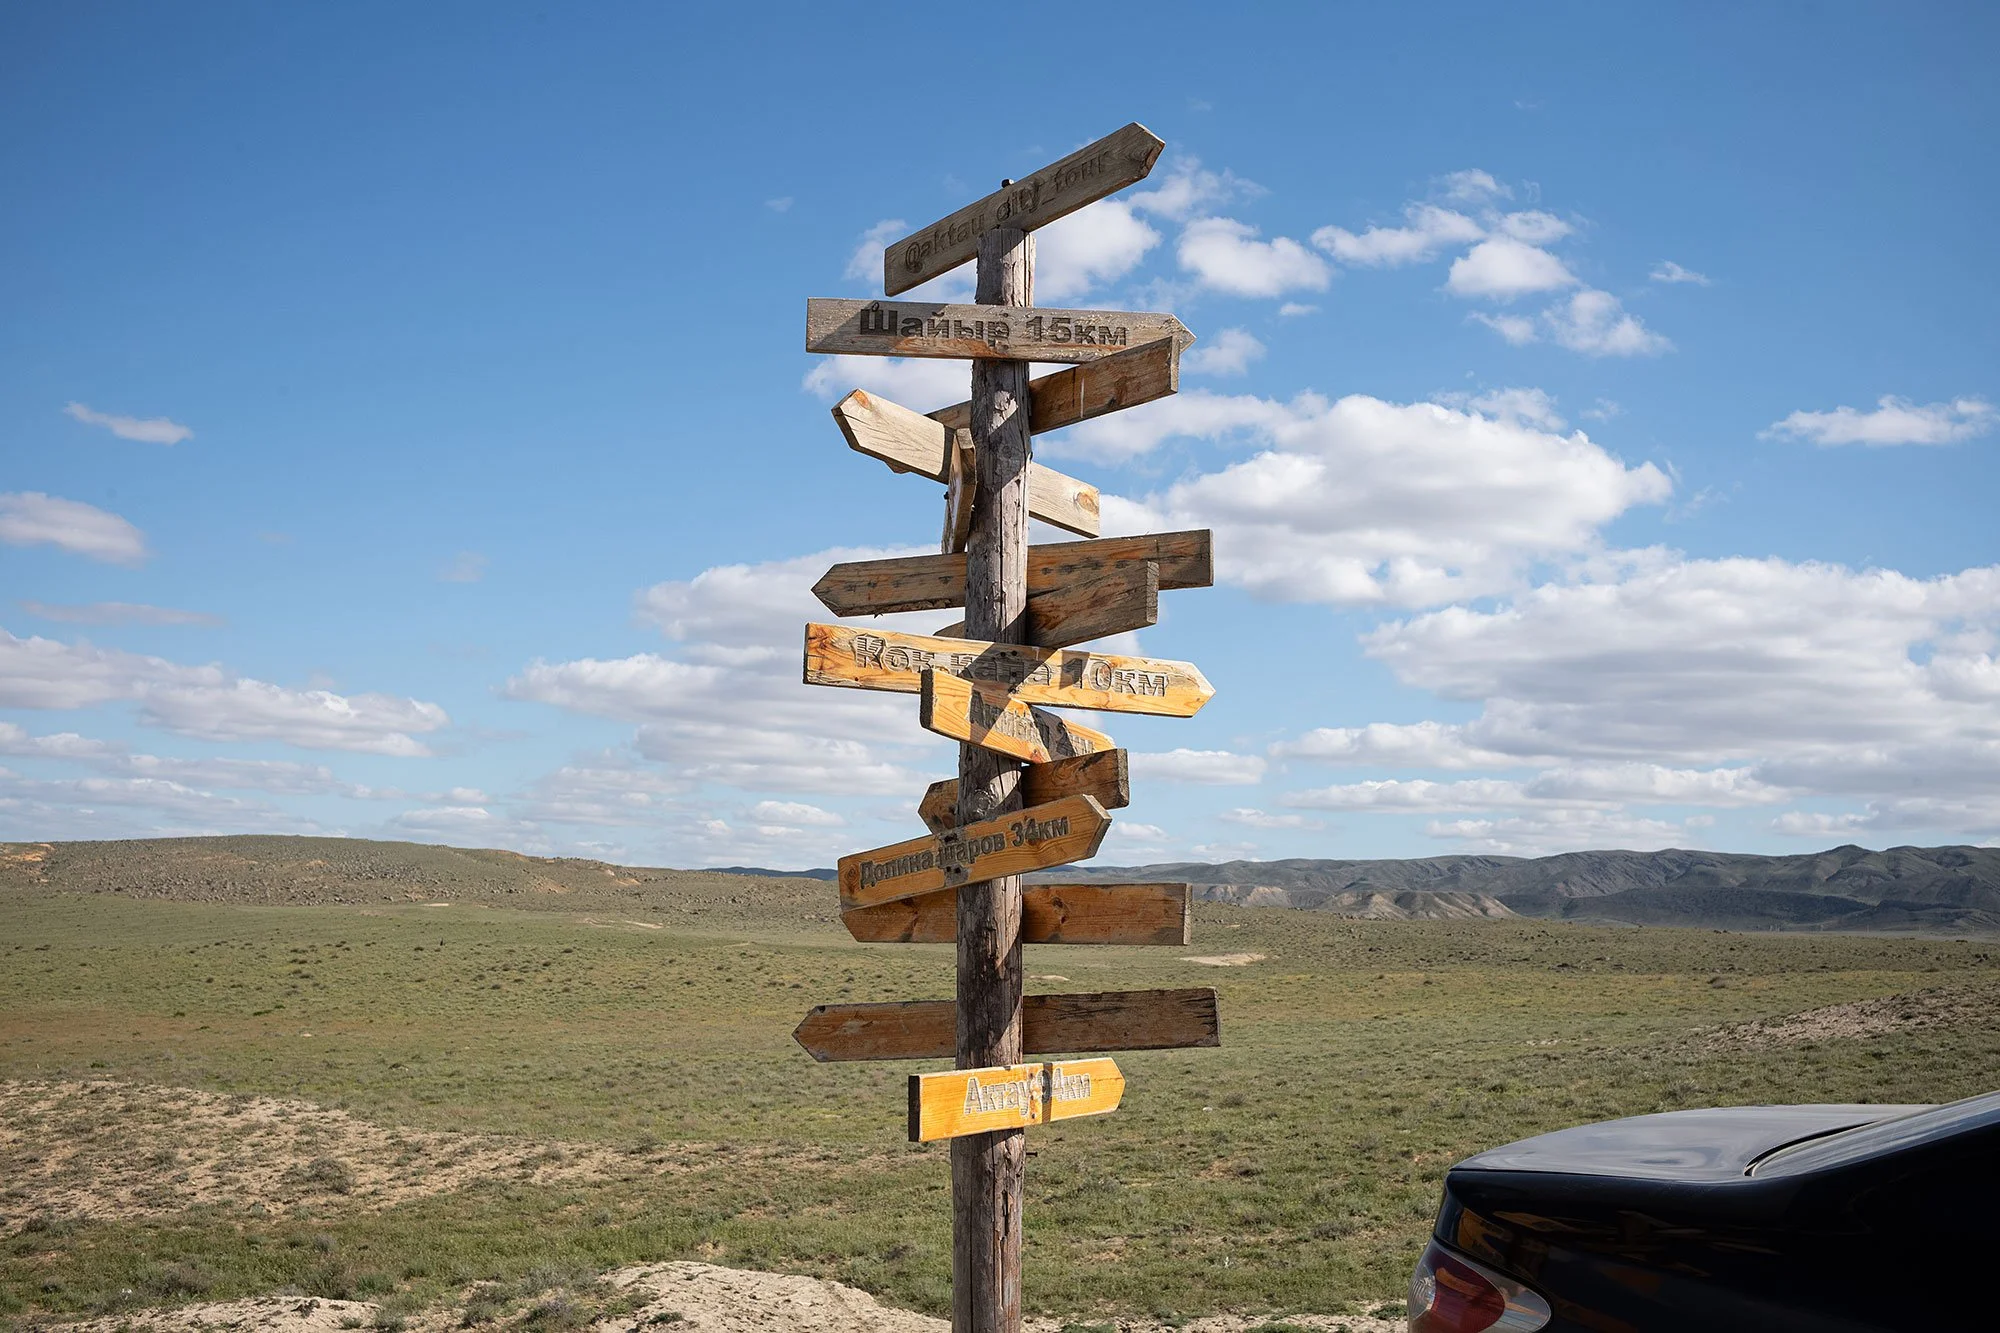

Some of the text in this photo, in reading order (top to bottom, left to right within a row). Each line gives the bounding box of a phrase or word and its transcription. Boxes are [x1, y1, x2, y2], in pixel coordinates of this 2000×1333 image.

[860, 308, 1127, 348] Шайыр 15км
[1061, 657, 1165, 696] 10км
[859, 816, 1069, 889] Долина шаров 34км
[964, 1077, 1032, 1116] Актау
